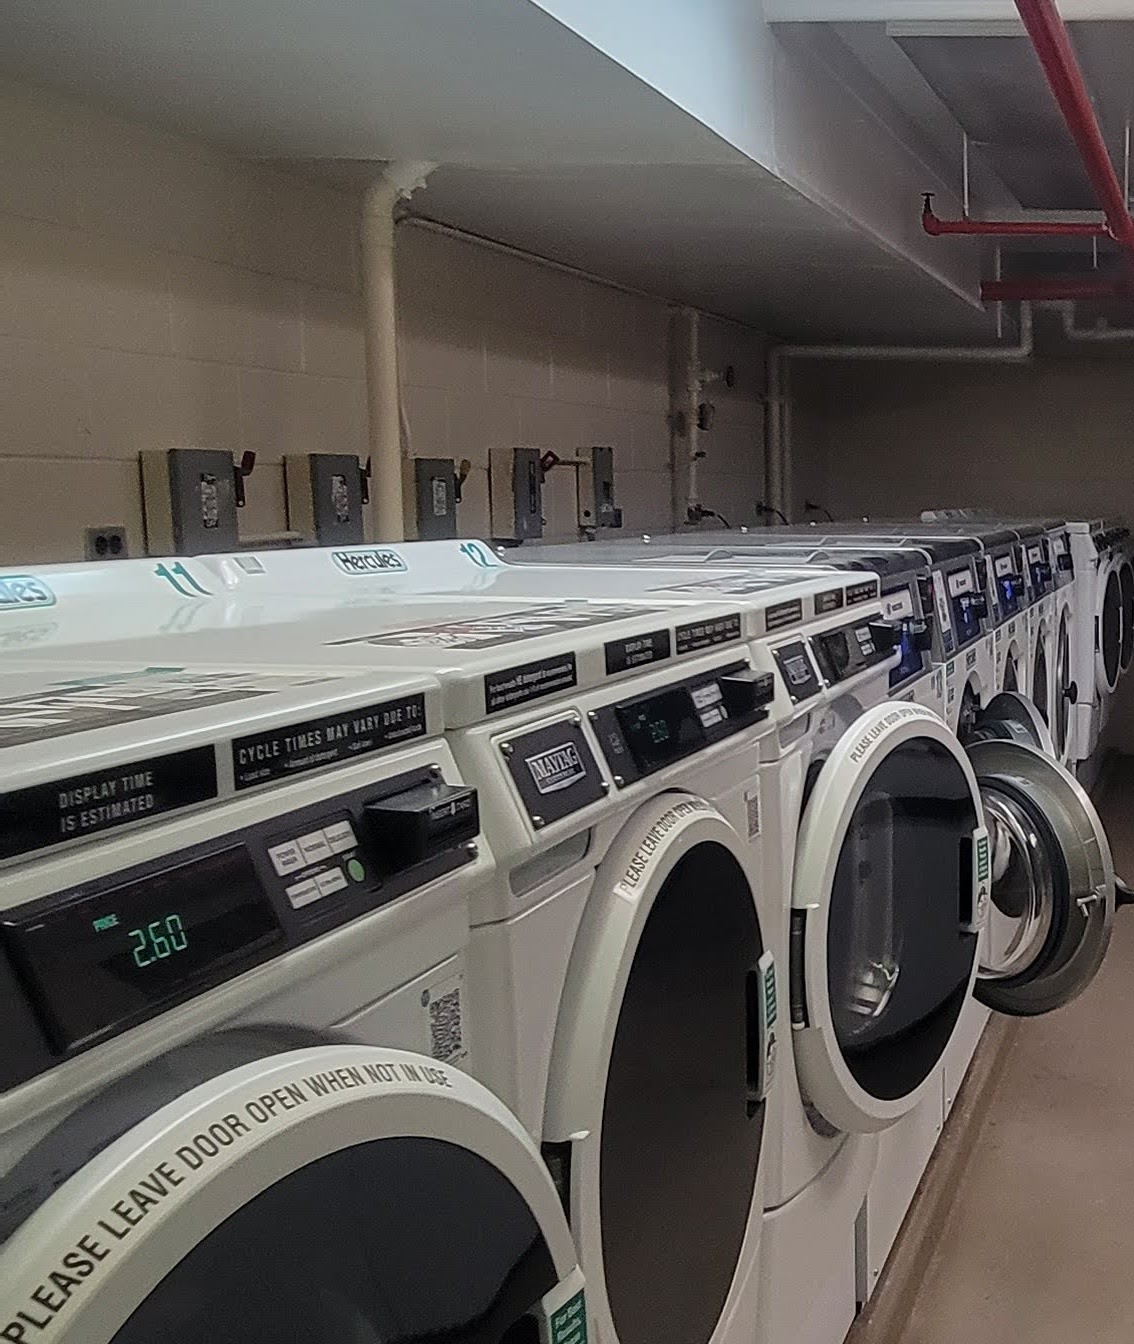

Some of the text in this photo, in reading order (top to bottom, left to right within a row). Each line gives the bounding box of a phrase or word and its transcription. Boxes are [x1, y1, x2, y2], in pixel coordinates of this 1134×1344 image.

[340, 551, 401, 570] Hercules
[460, 543, 500, 567] 12
[154, 561, 214, 597] 11
[239, 740, 281, 765] CYCLE
[284, 730, 322, 753] TIMES
[326, 723, 349, 742] MAY
[353, 714, 380, 734] VARY
[384, 708, 403, 726] DUE
[850, 735, 873, 764] PLEASE
[868, 720, 889, 740] LEAVE
[531, 747, 578, 780] MAYTAG
[59, 771, 154, 809] DISPLAY TIME
[60, 793, 155, 833] IS ESTIMATED
[619, 852, 649, 896] PLEASE
[640, 824, 665, 858] LEAVE
[657, 810, 678, 832] DOOR
[128, 914, 188, 967] 2.60
[97, 1161, 187, 1241] LEAVE
[175, 1113, 252, 1172] DOOR
[245, 1082, 307, 1125] OPEN
[301, 1065, 368, 1098] WHEN
[363, 1062, 400, 1085] NOT
[399, 1063, 419, 1084] IN
[422, 1068, 453, 1089] USE
